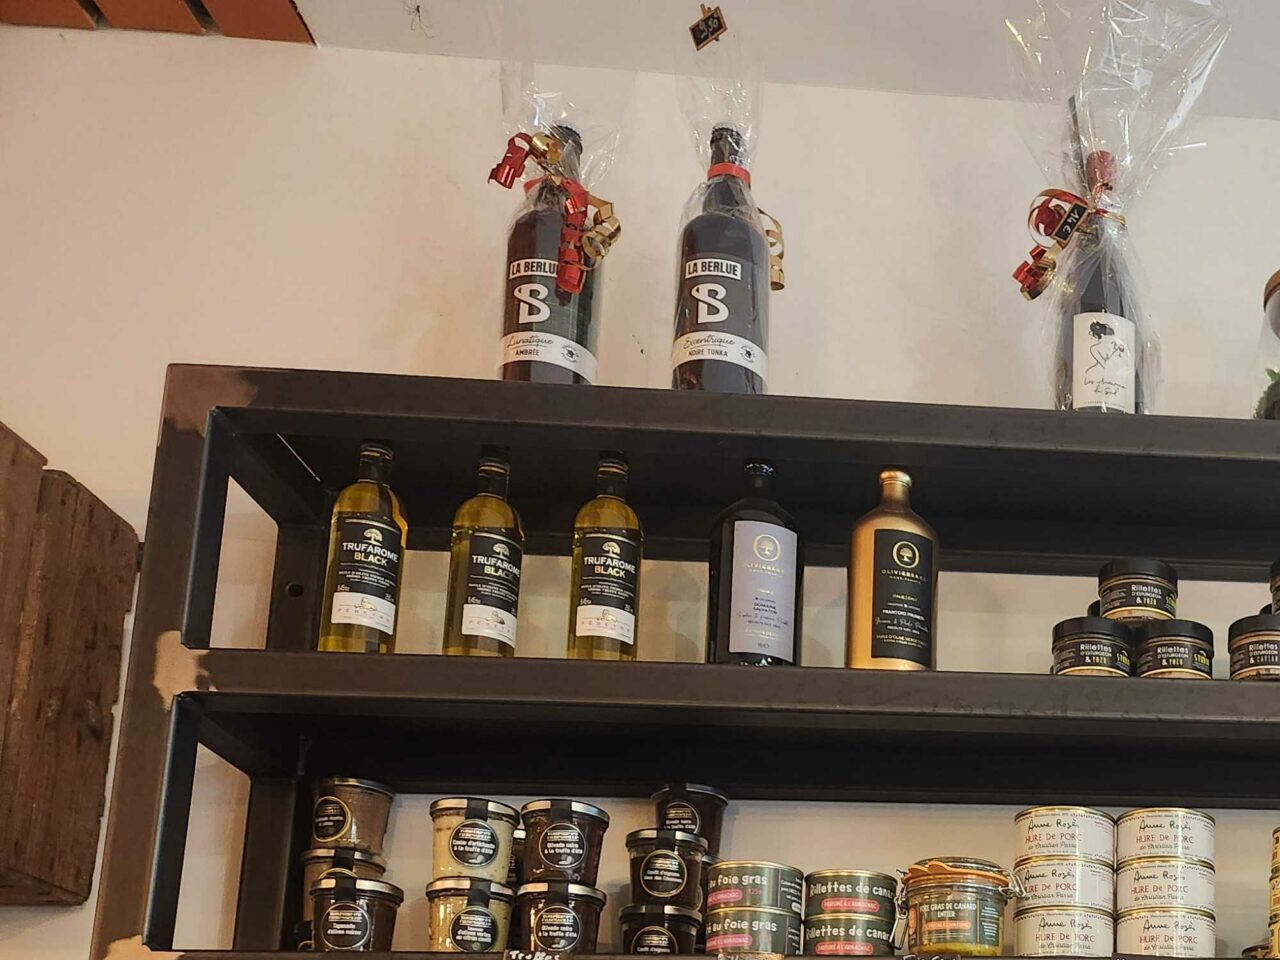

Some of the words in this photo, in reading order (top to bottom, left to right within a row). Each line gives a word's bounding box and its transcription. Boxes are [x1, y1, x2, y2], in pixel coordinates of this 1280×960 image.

[511, 262, 522, 275] LA
[687, 261, 698, 275] LA
[700, 261, 739, 276] BERLUE
[342, 542, 399, 563] TRUFAROME
[354, 552, 388, 567] BLACK
[471, 554, 521, 575] TRUFAROME
[583, 556, 636, 574] TRUFAROME
[484, 566, 514, 580] BLACK
[594, 565, 626, 578] BLACK
[1131, 585, 1162, 595] Rillettes
[1080, 644, 1112, 652] Rillettes
[1157, 646, 1189, 654] Rillettes
[1249, 643, 1279, 652] Rillettes
[1026, 834, 1041, 842] HURE
[1136, 834, 1155, 843] HURE
[718, 875, 738, 885] foie
[742, 875, 768, 885] gras
[810, 884, 850, 896] Rillettes
[856, 882, 869, 893] de
[1055, 884, 1076, 892] PORC
[1131, 886, 1149, 895] HURE
[724, 919, 748, 929] foie
[752, 920, 778, 931] gras
[850, 925, 863, 936] de
[1035, 933, 1055, 942] HURE
